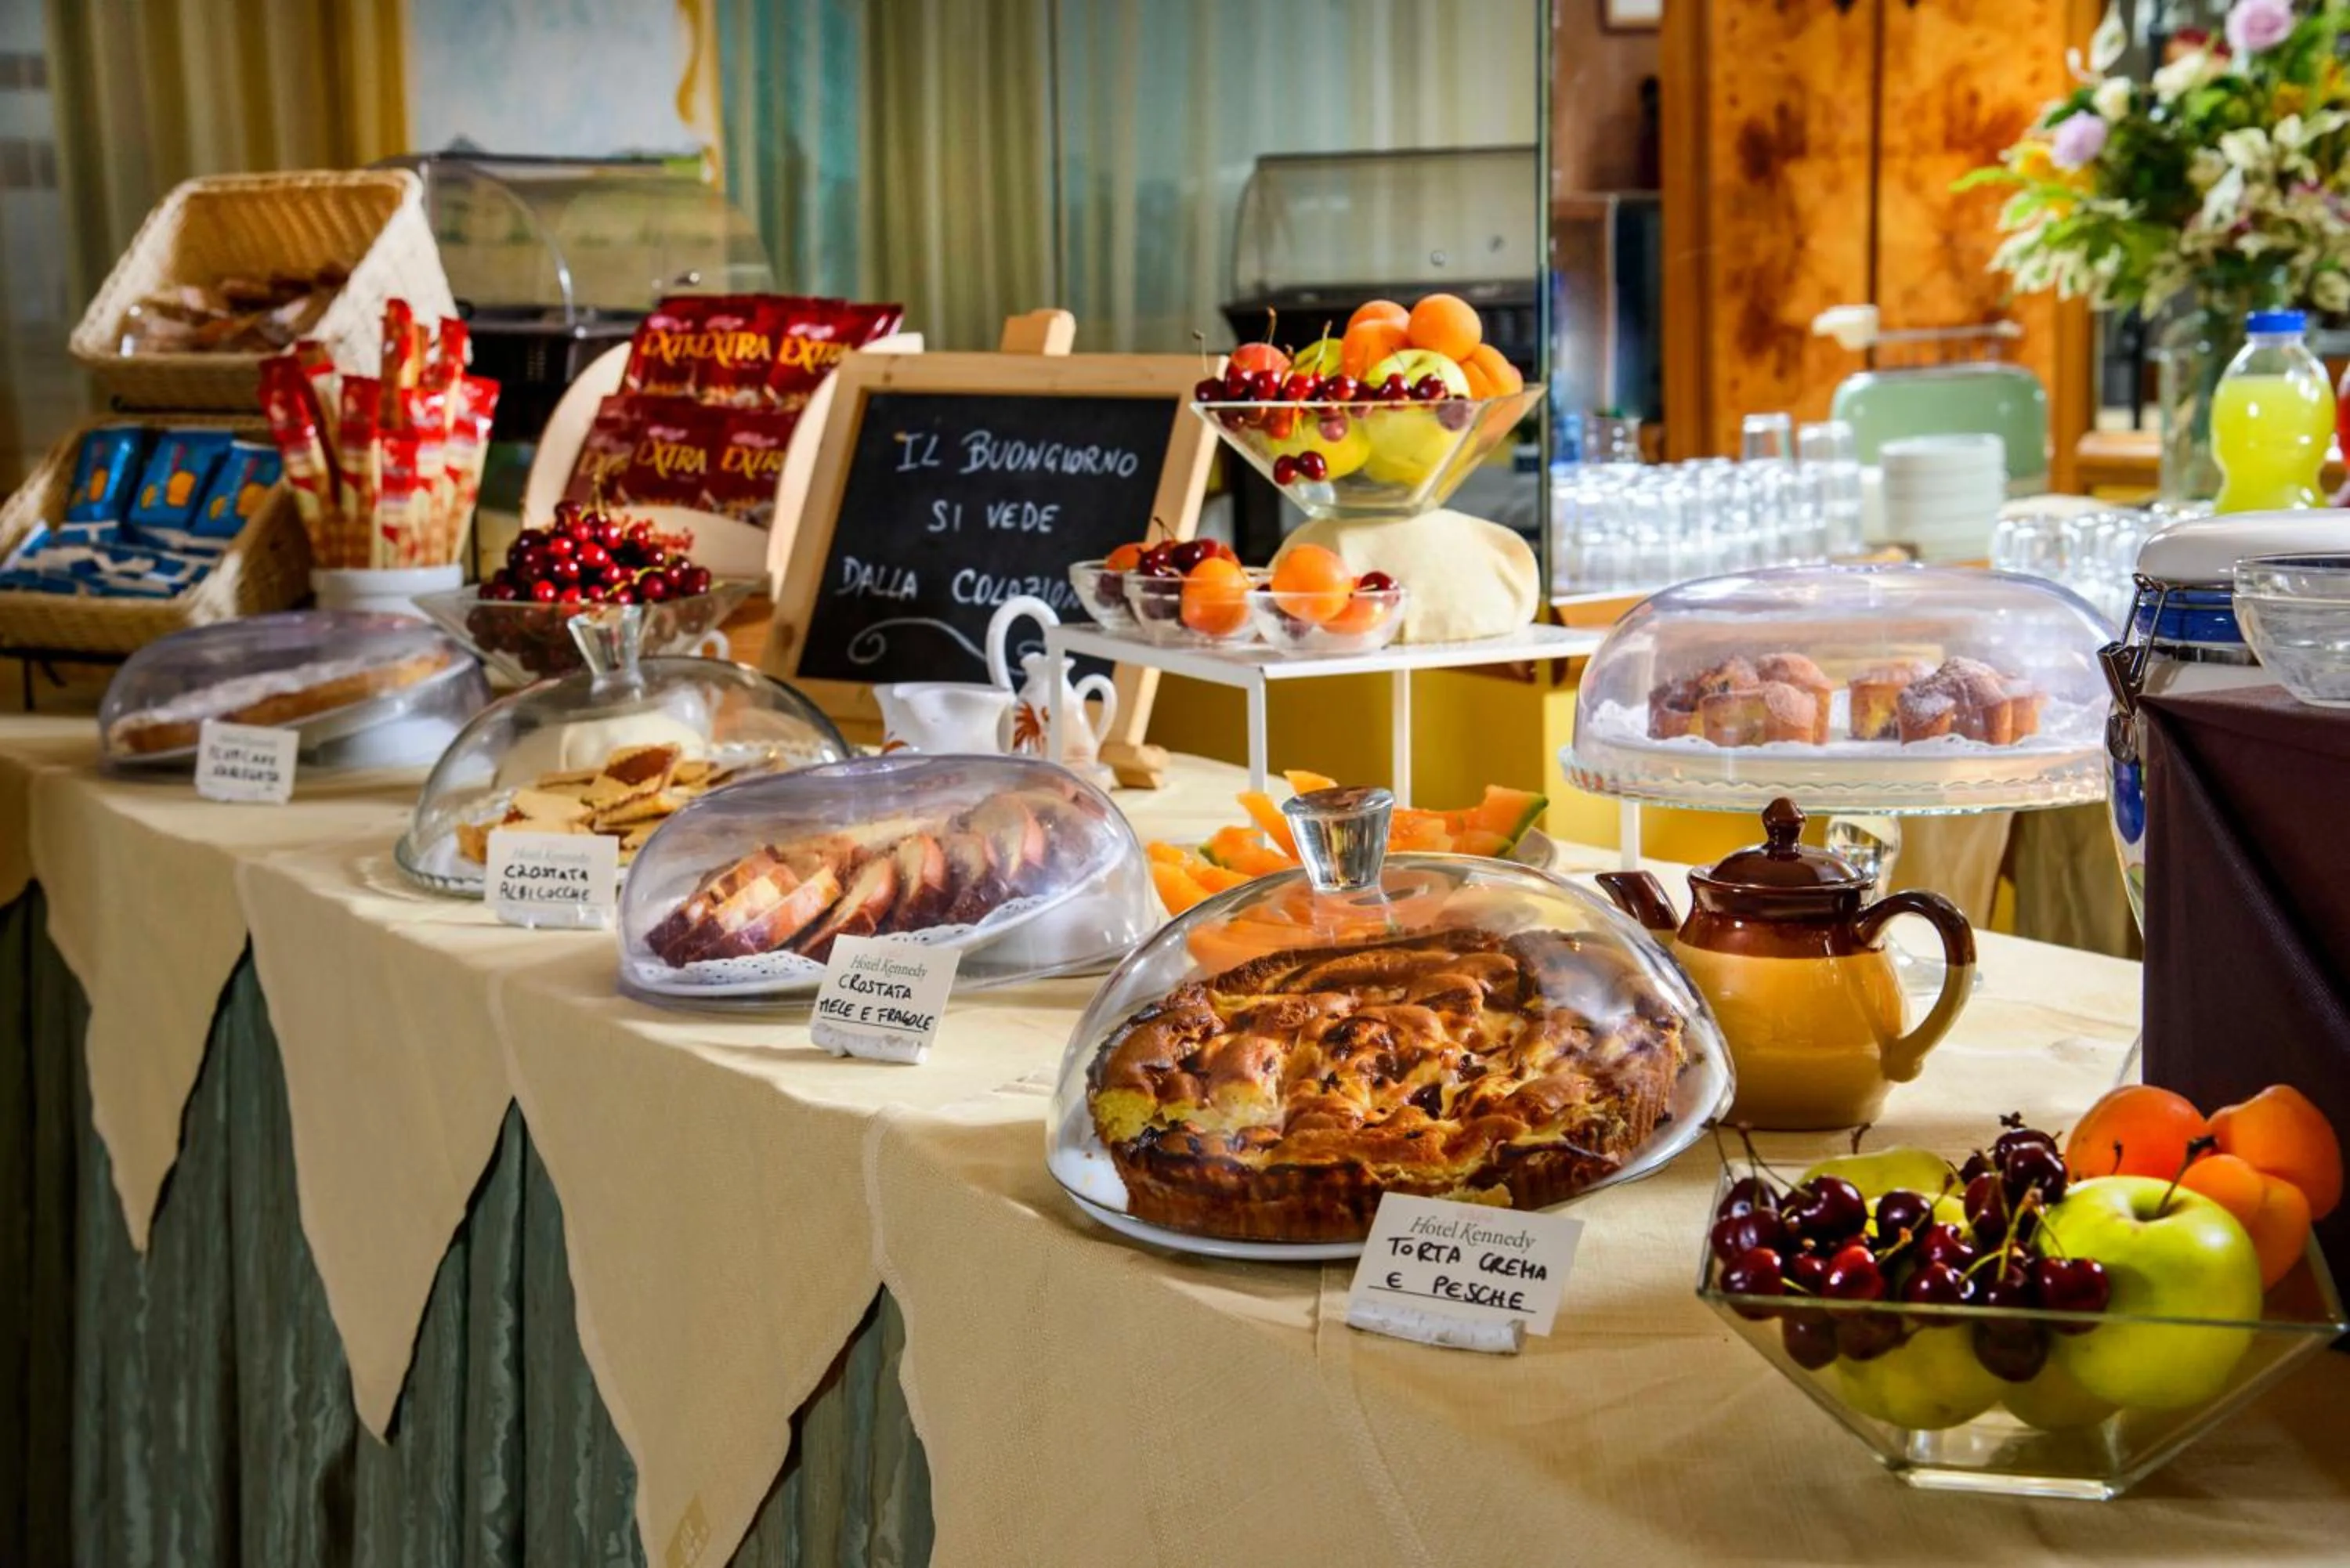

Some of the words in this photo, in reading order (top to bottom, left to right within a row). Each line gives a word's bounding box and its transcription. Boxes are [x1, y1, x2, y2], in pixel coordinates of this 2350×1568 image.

[634, 438, 707, 480] EXTRA
[895, 432, 942, 471] IL
[960, 430, 1138, 477] BUONGIORNO
[927, 500, 962, 532] SI
[987, 503, 1061, 533] VEDE
[837, 557, 918, 599] DALLA
[951, 569, 1082, 610] COLAZION
[504, 864, 590, 882] CROSTATA
[850, 954, 882, 972] Hotel
[882, 958, 928, 978] Kennedy
[838, 973, 912, 999] CROSTATA
[860, 1006, 873, 1021] E
[877, 1007, 935, 1031] FRAGOLE
[1409, 1216, 1459, 1239] Hotel
[1460, 1223, 1537, 1251] Kennedy
[1479, 1252, 1548, 1281] CREMA
[1386, 1271, 1403, 1288] E
[1432, 1275, 1525, 1311] PESCHE
